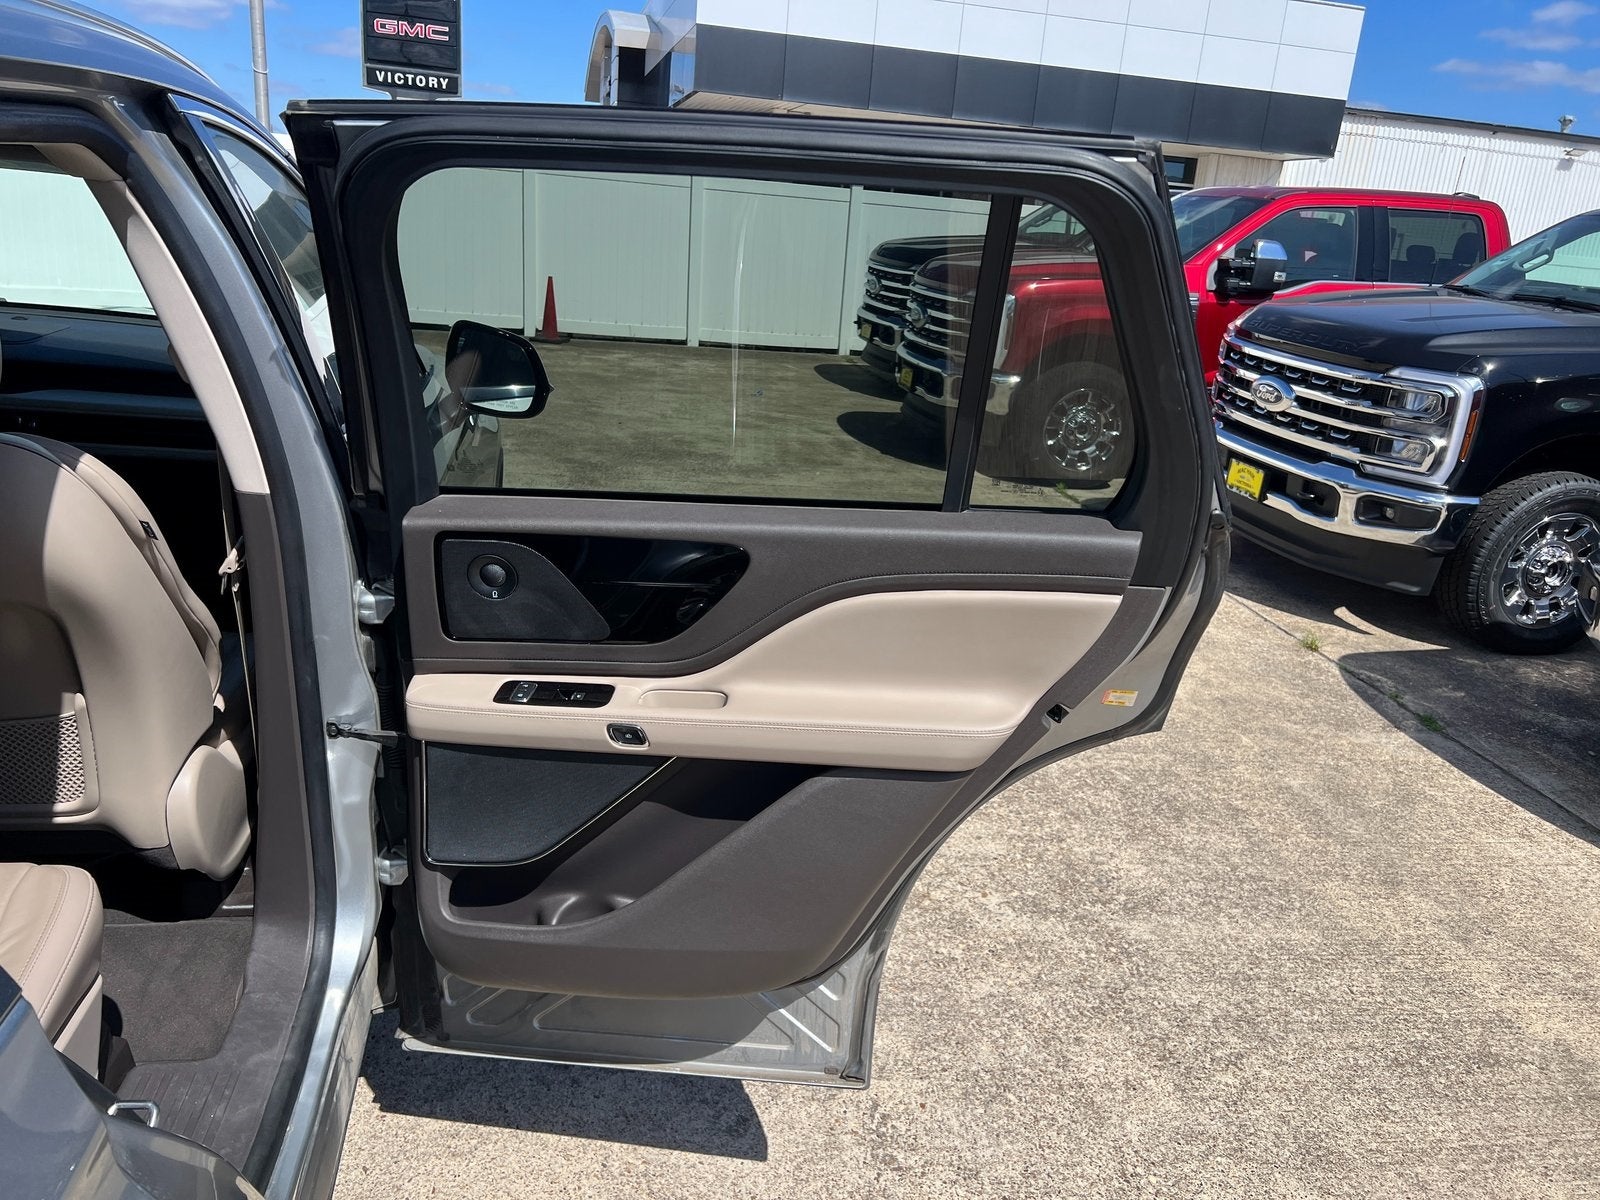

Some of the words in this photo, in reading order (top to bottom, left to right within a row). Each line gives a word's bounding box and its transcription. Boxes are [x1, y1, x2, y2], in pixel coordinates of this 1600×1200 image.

[374, 18, 449, 41] GMC
[375, 70, 449, 89] VICTORY
[1256, 384, 1278, 402] Ford
